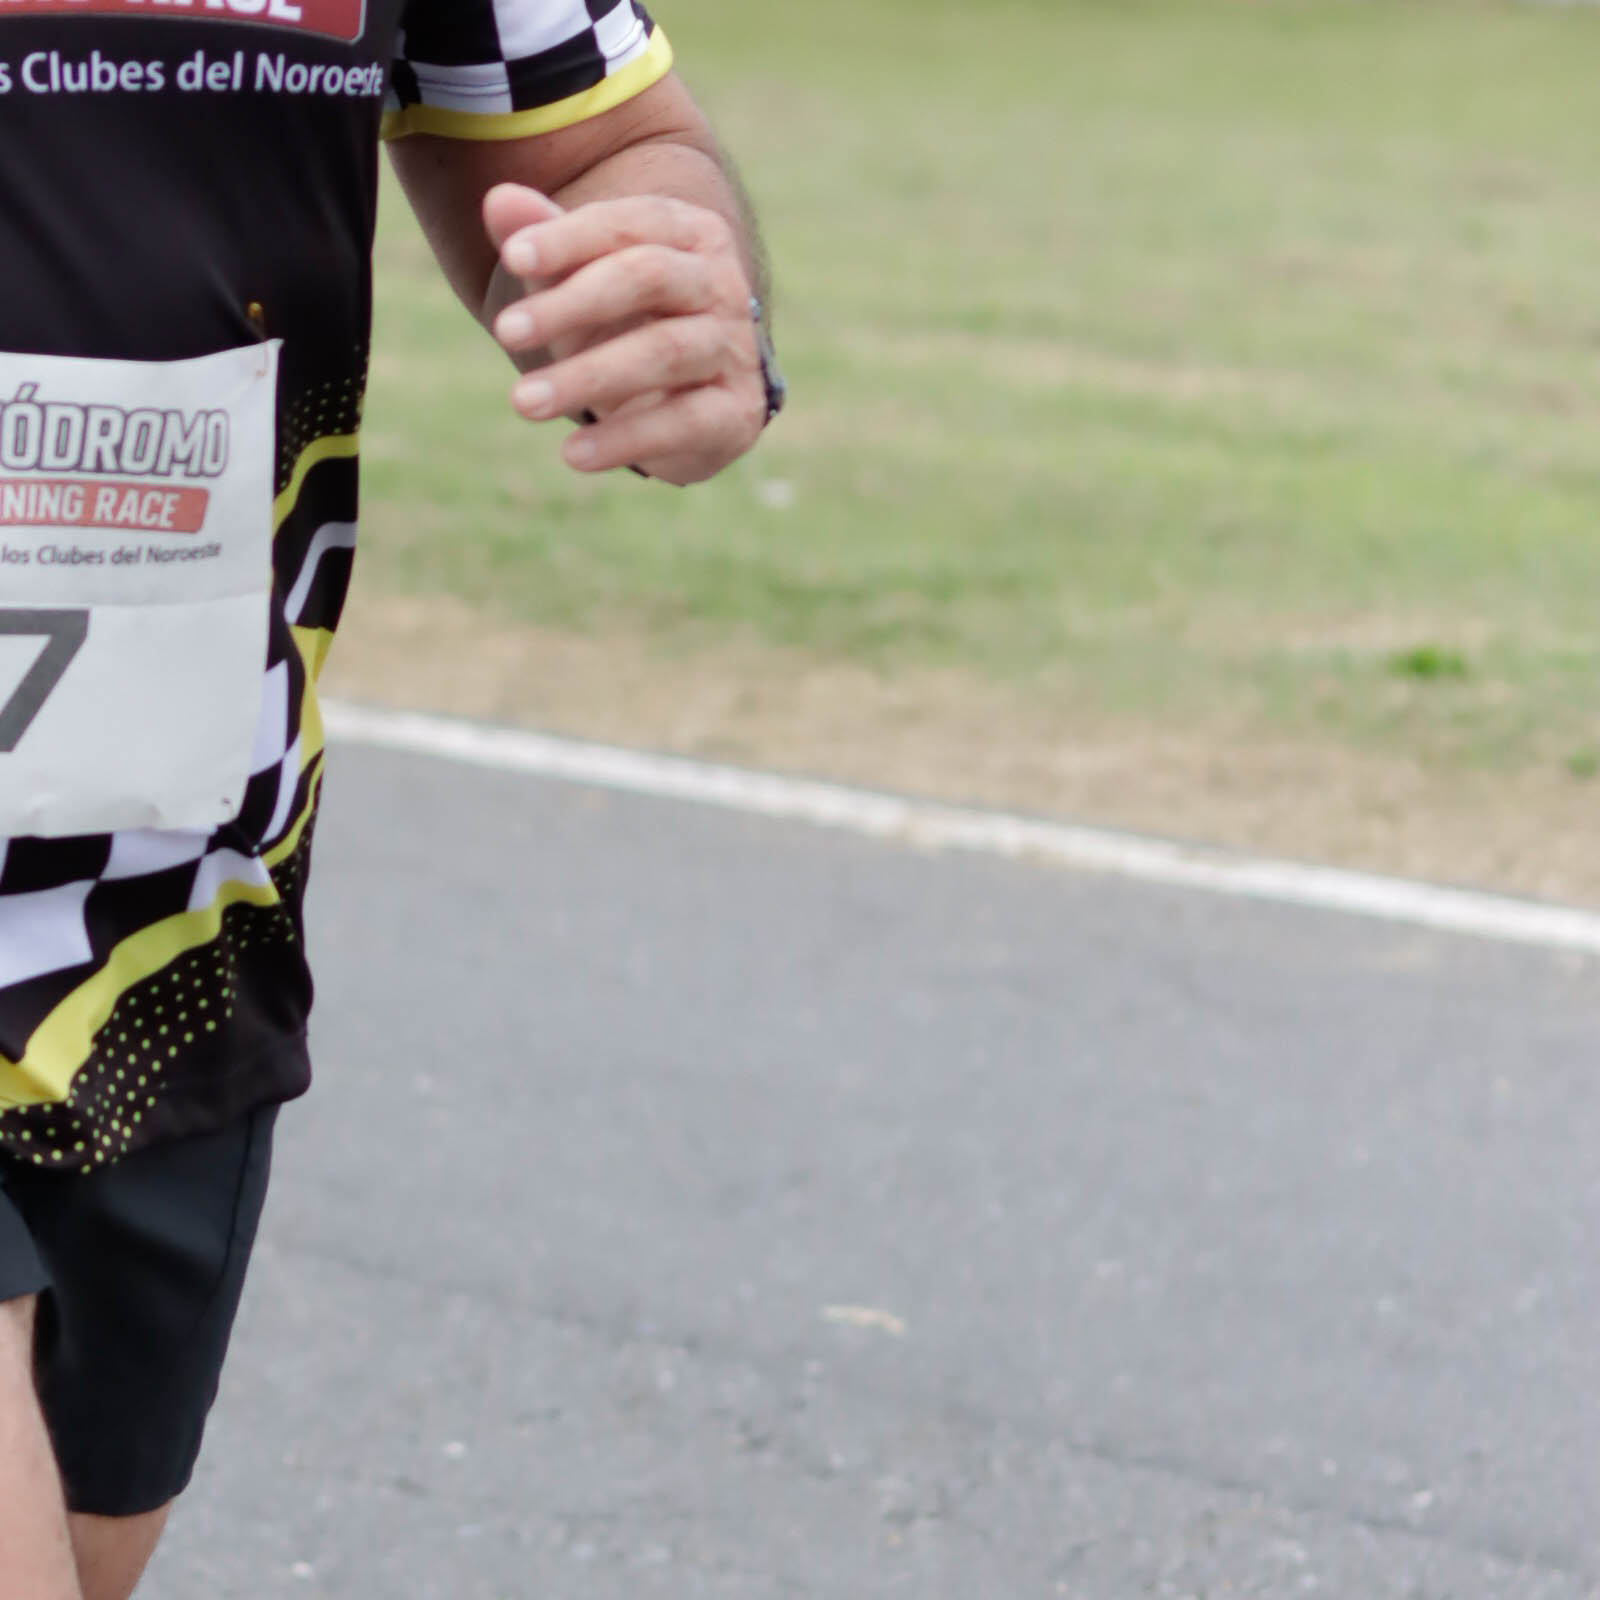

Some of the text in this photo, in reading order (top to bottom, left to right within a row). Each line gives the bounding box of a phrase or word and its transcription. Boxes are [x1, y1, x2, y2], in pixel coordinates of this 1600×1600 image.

[22, 50, 165, 93] Clubes
[176, 50, 244, 91] del
[92, 489, 181, 528] RACE
[1, 542, 31, 566] los
[36, 544, 105, 567] Clubes
[110, 543, 142, 565] del
[146, 541, 223, 564] Noroeste
